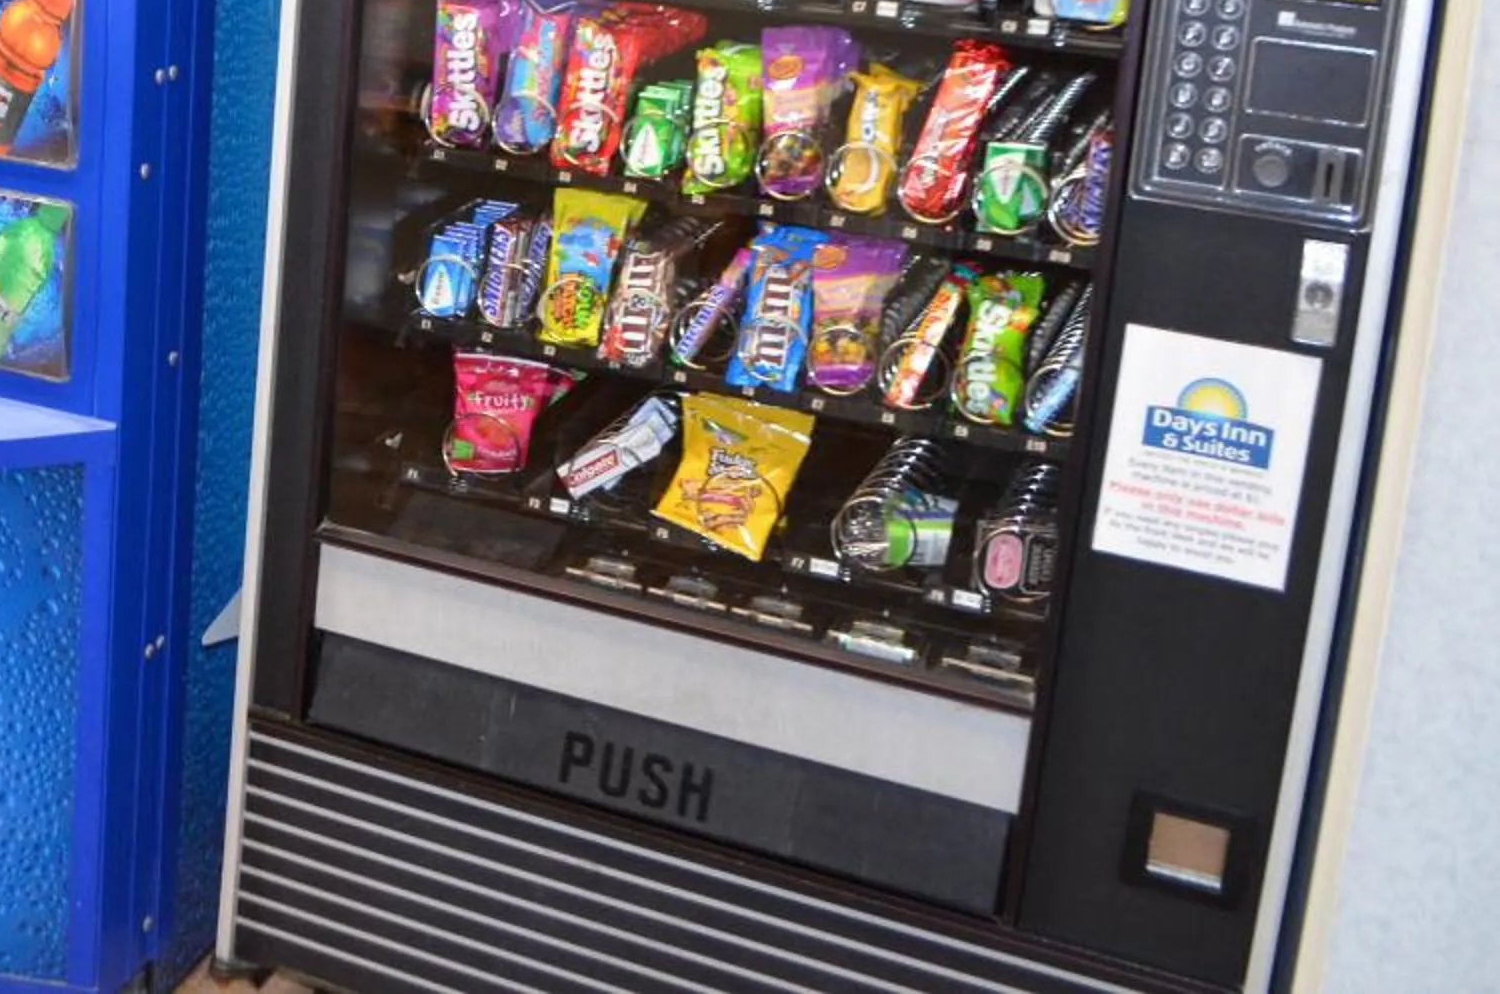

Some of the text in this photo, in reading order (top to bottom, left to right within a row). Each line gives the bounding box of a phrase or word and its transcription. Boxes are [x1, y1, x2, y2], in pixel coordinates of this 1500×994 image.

[447, 13, 479, 132] Skittles
[569, 34, 615, 152] Skittles
[692, 66, 729, 174] Skittles
[963, 300, 1010, 415] Skittles
[1152, 409, 1267, 447] Days Inn
[1162, 432, 1250, 462] & Suites
[558, 730, 713, 822] PUSH
